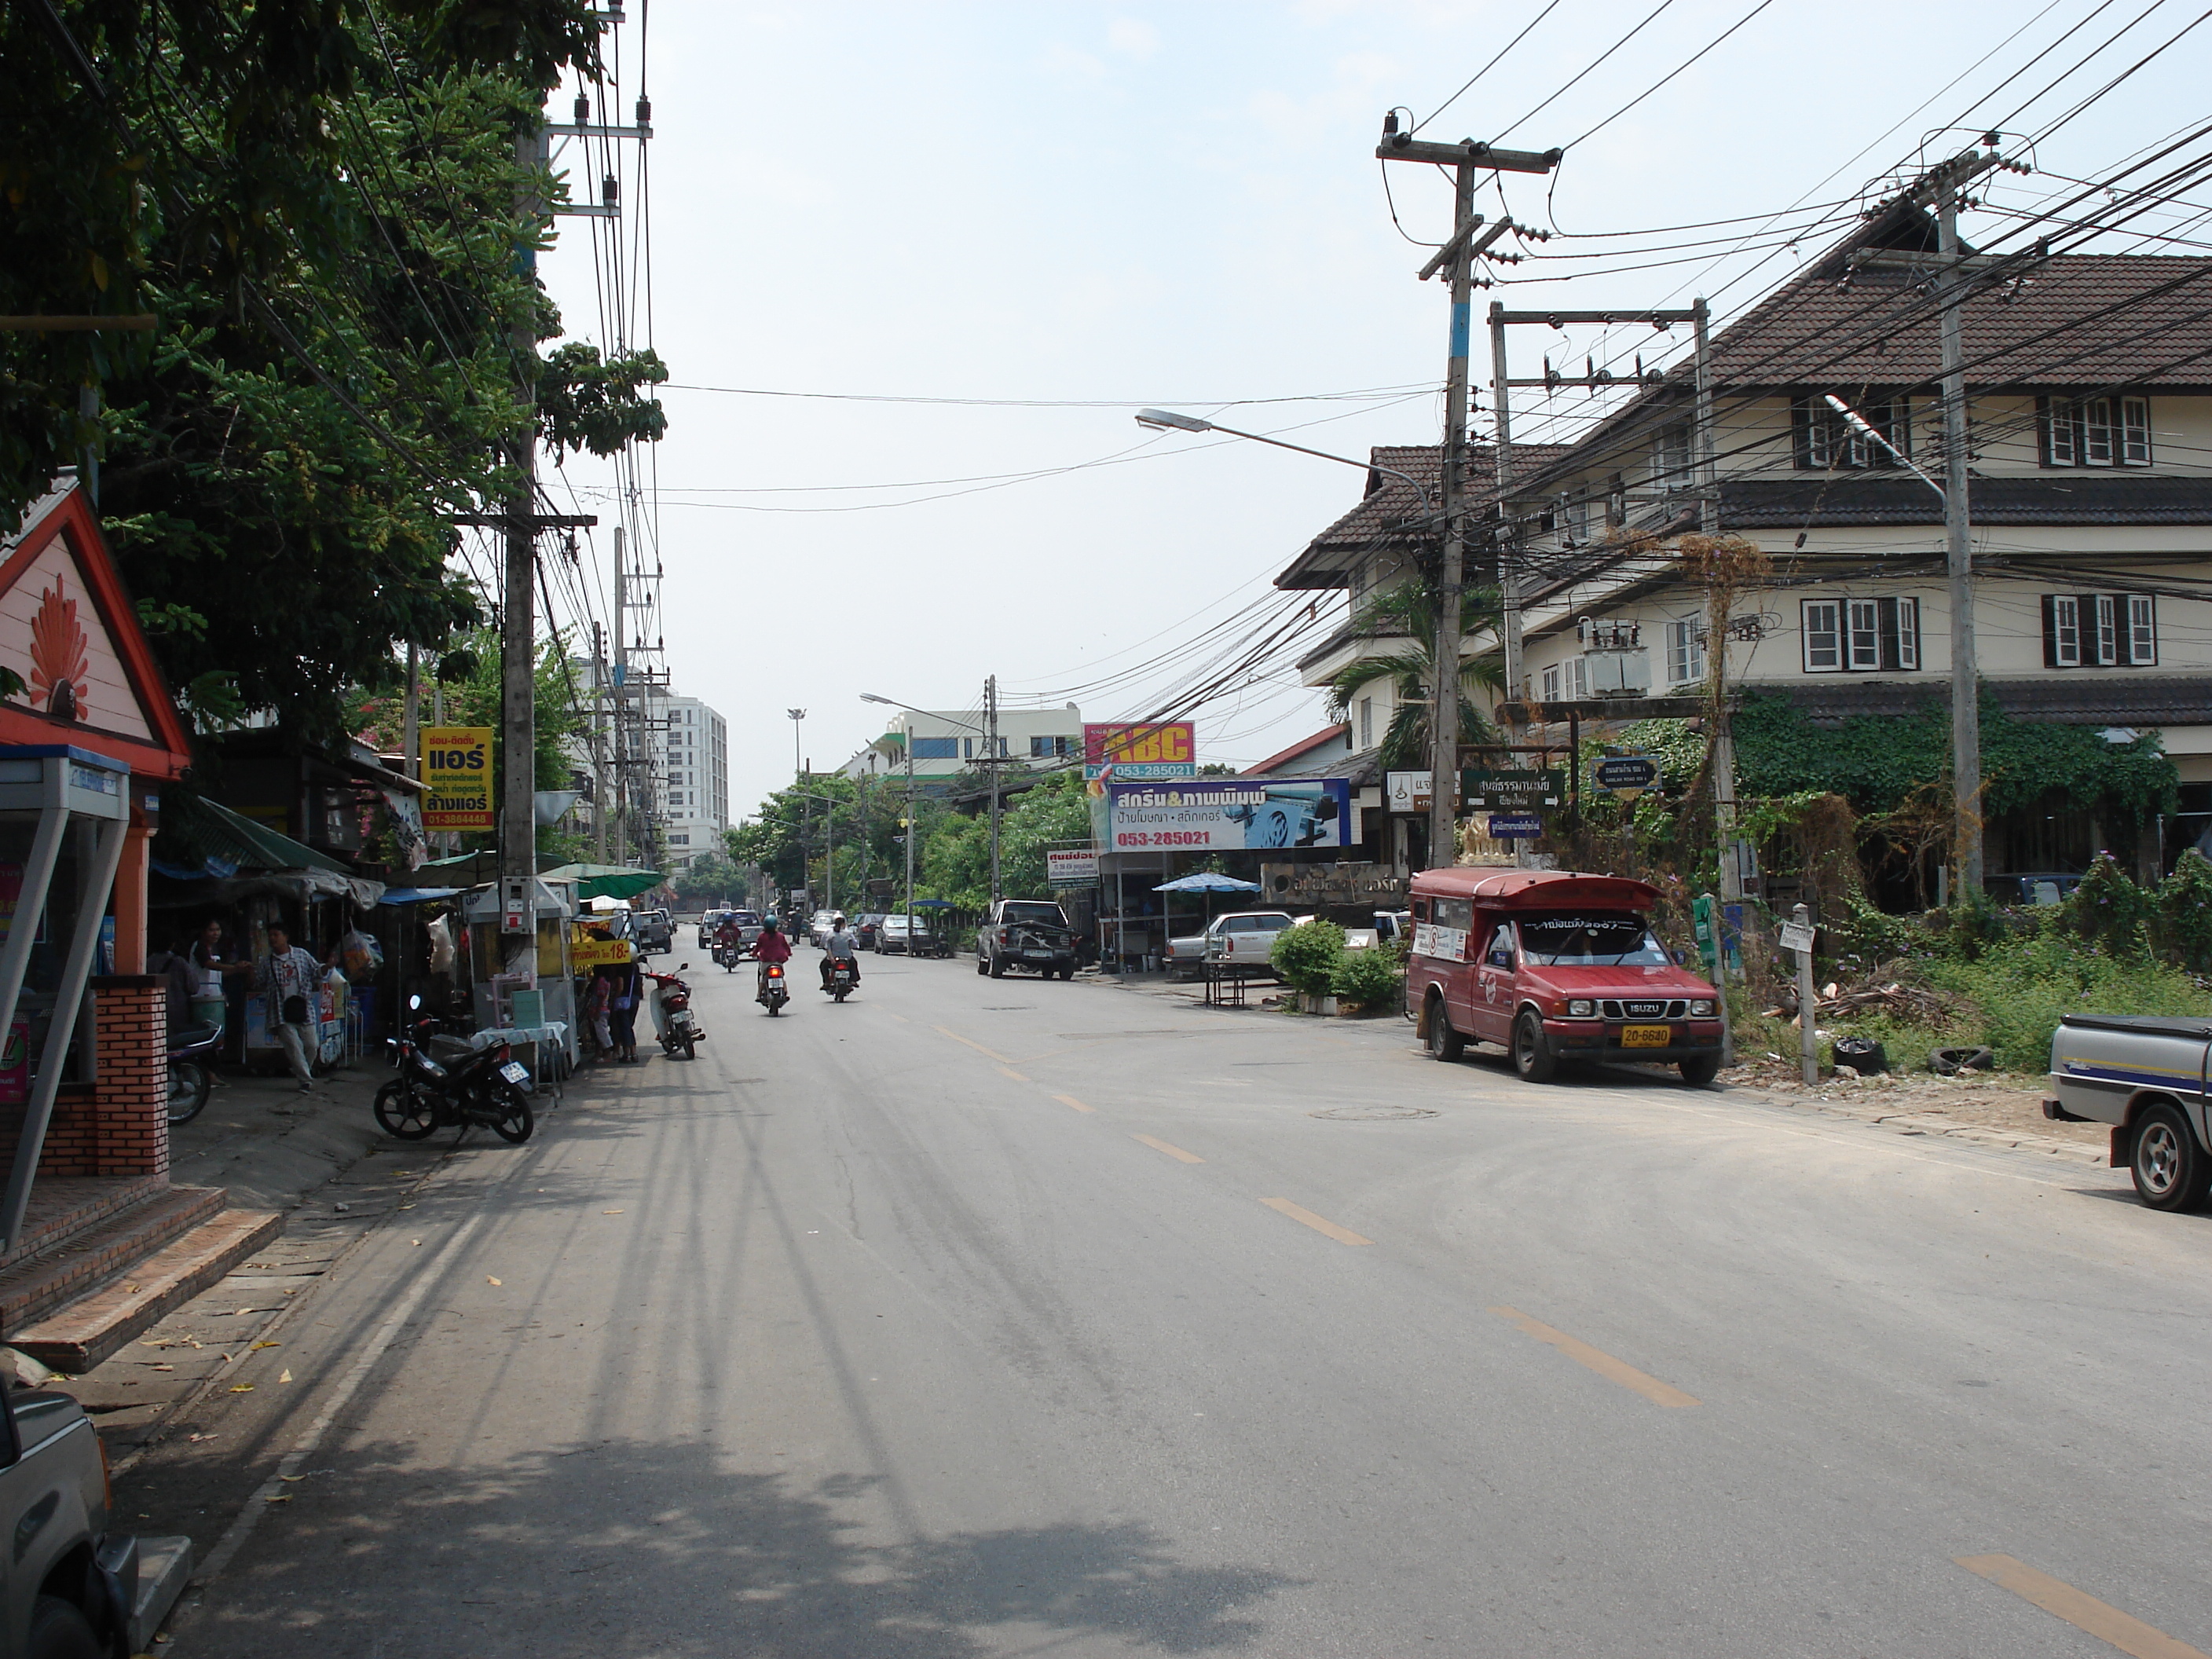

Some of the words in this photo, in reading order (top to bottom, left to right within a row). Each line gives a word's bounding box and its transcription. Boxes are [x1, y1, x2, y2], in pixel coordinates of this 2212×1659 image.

[1101, 727, 1188, 762] ABC
[429, 743, 485, 770] แอร์
[1115, 765, 1192, 776] 053-285021
[427, 793, 487, 811] ล้างแอร์
[1117, 786, 1267, 808] สกรีน&ภาพพิมพ์
[1117, 831, 1210, 847] 053-285021
[1630, 1004, 1660, 1013] ISUZU
